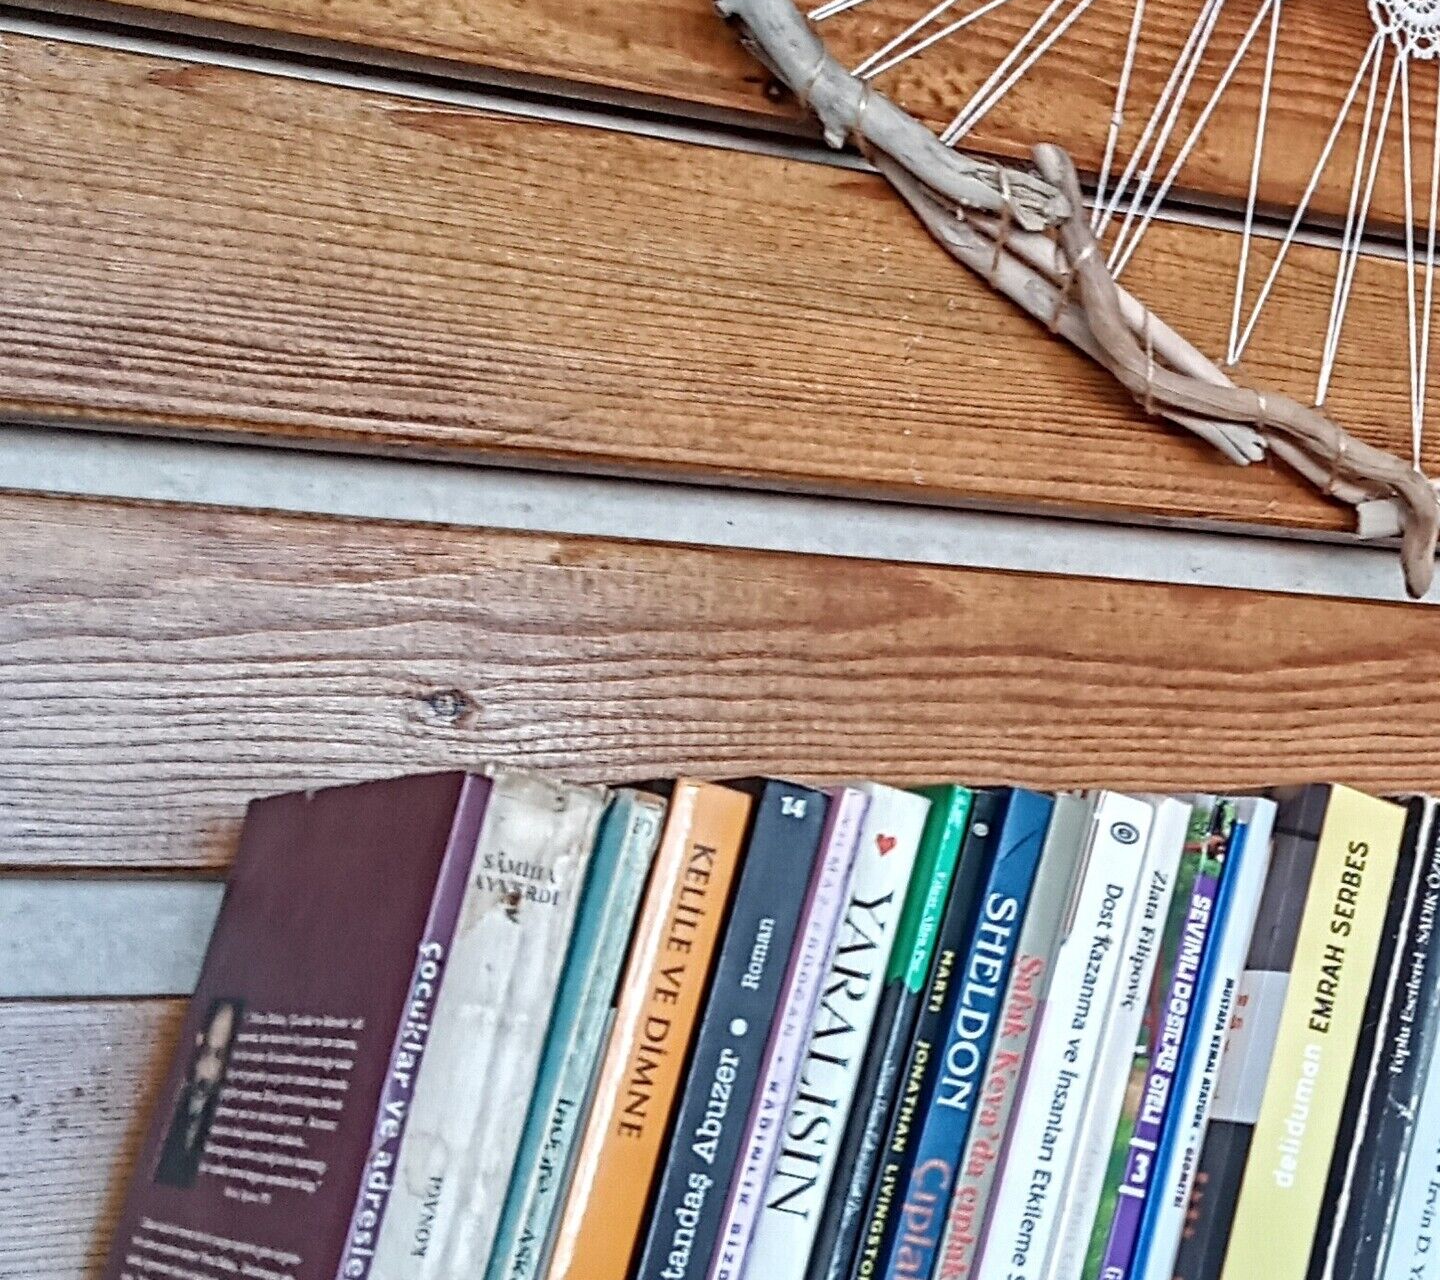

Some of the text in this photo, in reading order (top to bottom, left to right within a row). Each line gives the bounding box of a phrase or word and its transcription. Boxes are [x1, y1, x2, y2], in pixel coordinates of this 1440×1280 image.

[780, 795, 807, 819] 14
[667, 843, 720, 955] KELİLE
[1096, 883, 1125, 930] Dost
[1142, 870, 1169, 922] Zlata
[1414, 891, 1440, 946] SADIK
[389, 940, 445, 1088] çocuklar
[653, 961, 685, 1005] VE
[928, 950, 955, 1012] MARTI
[935, 891, 1020, 1111] SHELDON
[995, 952, 1044, 1042] Şafak
[1070, 934, 1112, 1031] Kazanma
[1213, 978, 1235, 1032] MUSTAFA
[1271, 838, 1371, 1189] deliduman EMRAH SERBES
[617, 1016, 673, 1142] DİMNE
[690, 1046, 739, 1163] Abuzer
[740, 916, 774, 990] Roman
[762, 881, 898, 1220] YARALISIN
[1062, 1035, 1082, 1063] ve
[379, 1098, 405, 1139] ve
[888, 1040, 932, 1152] JONATHAN
[1009, 1168, 1052, 1267] Etkileme
